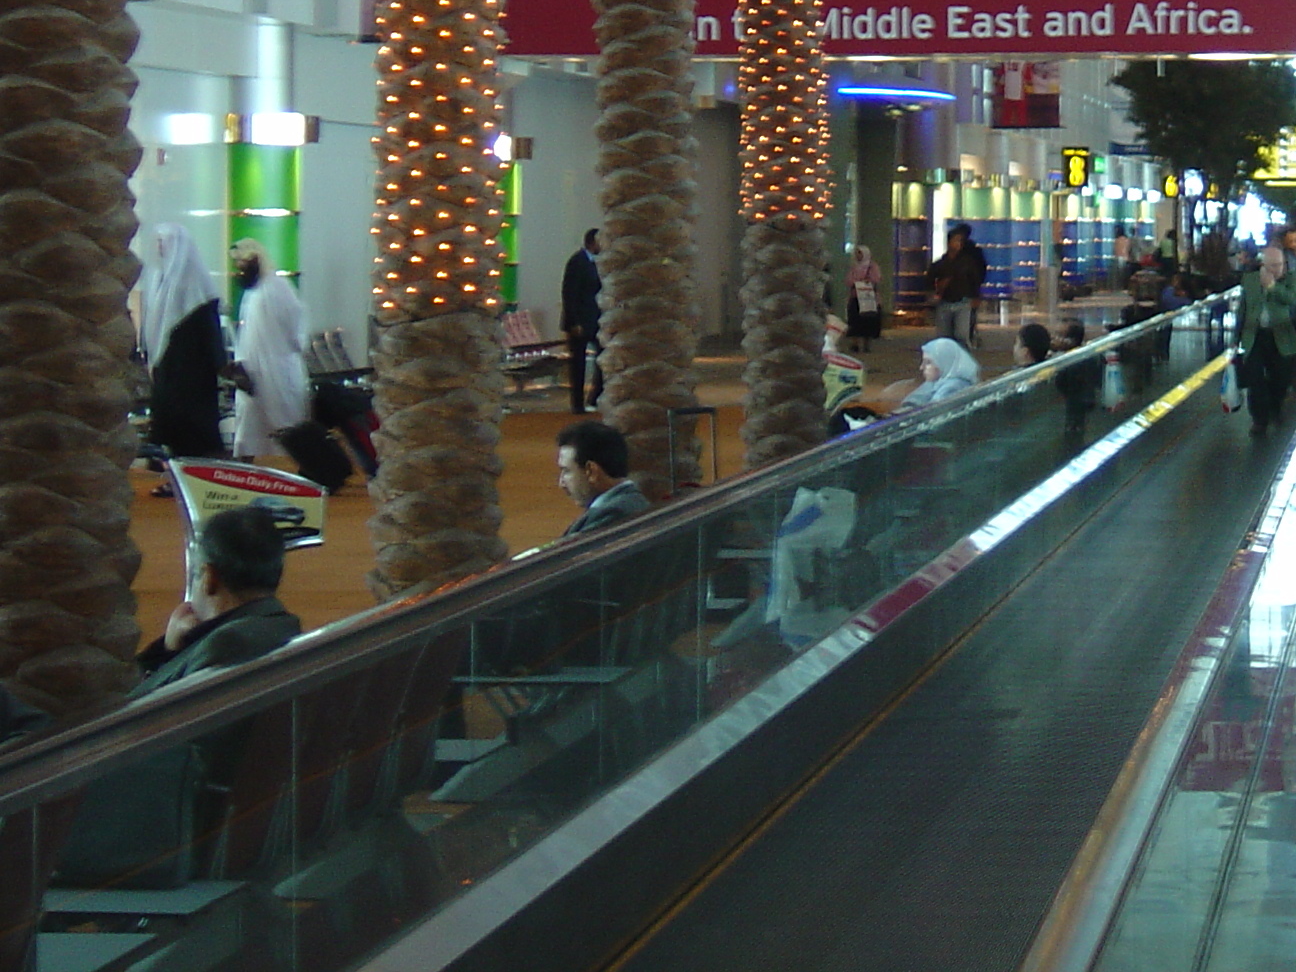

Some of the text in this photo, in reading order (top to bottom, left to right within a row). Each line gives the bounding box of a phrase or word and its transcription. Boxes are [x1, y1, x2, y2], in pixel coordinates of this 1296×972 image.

[946, 2, 1033, 39] East
[1042, 2, 1117, 37] and
[1124, 0, 1255, 37] Africa.
[1069, 155, 1086, 187] 8
[1164, 174, 1179, 197] 6
